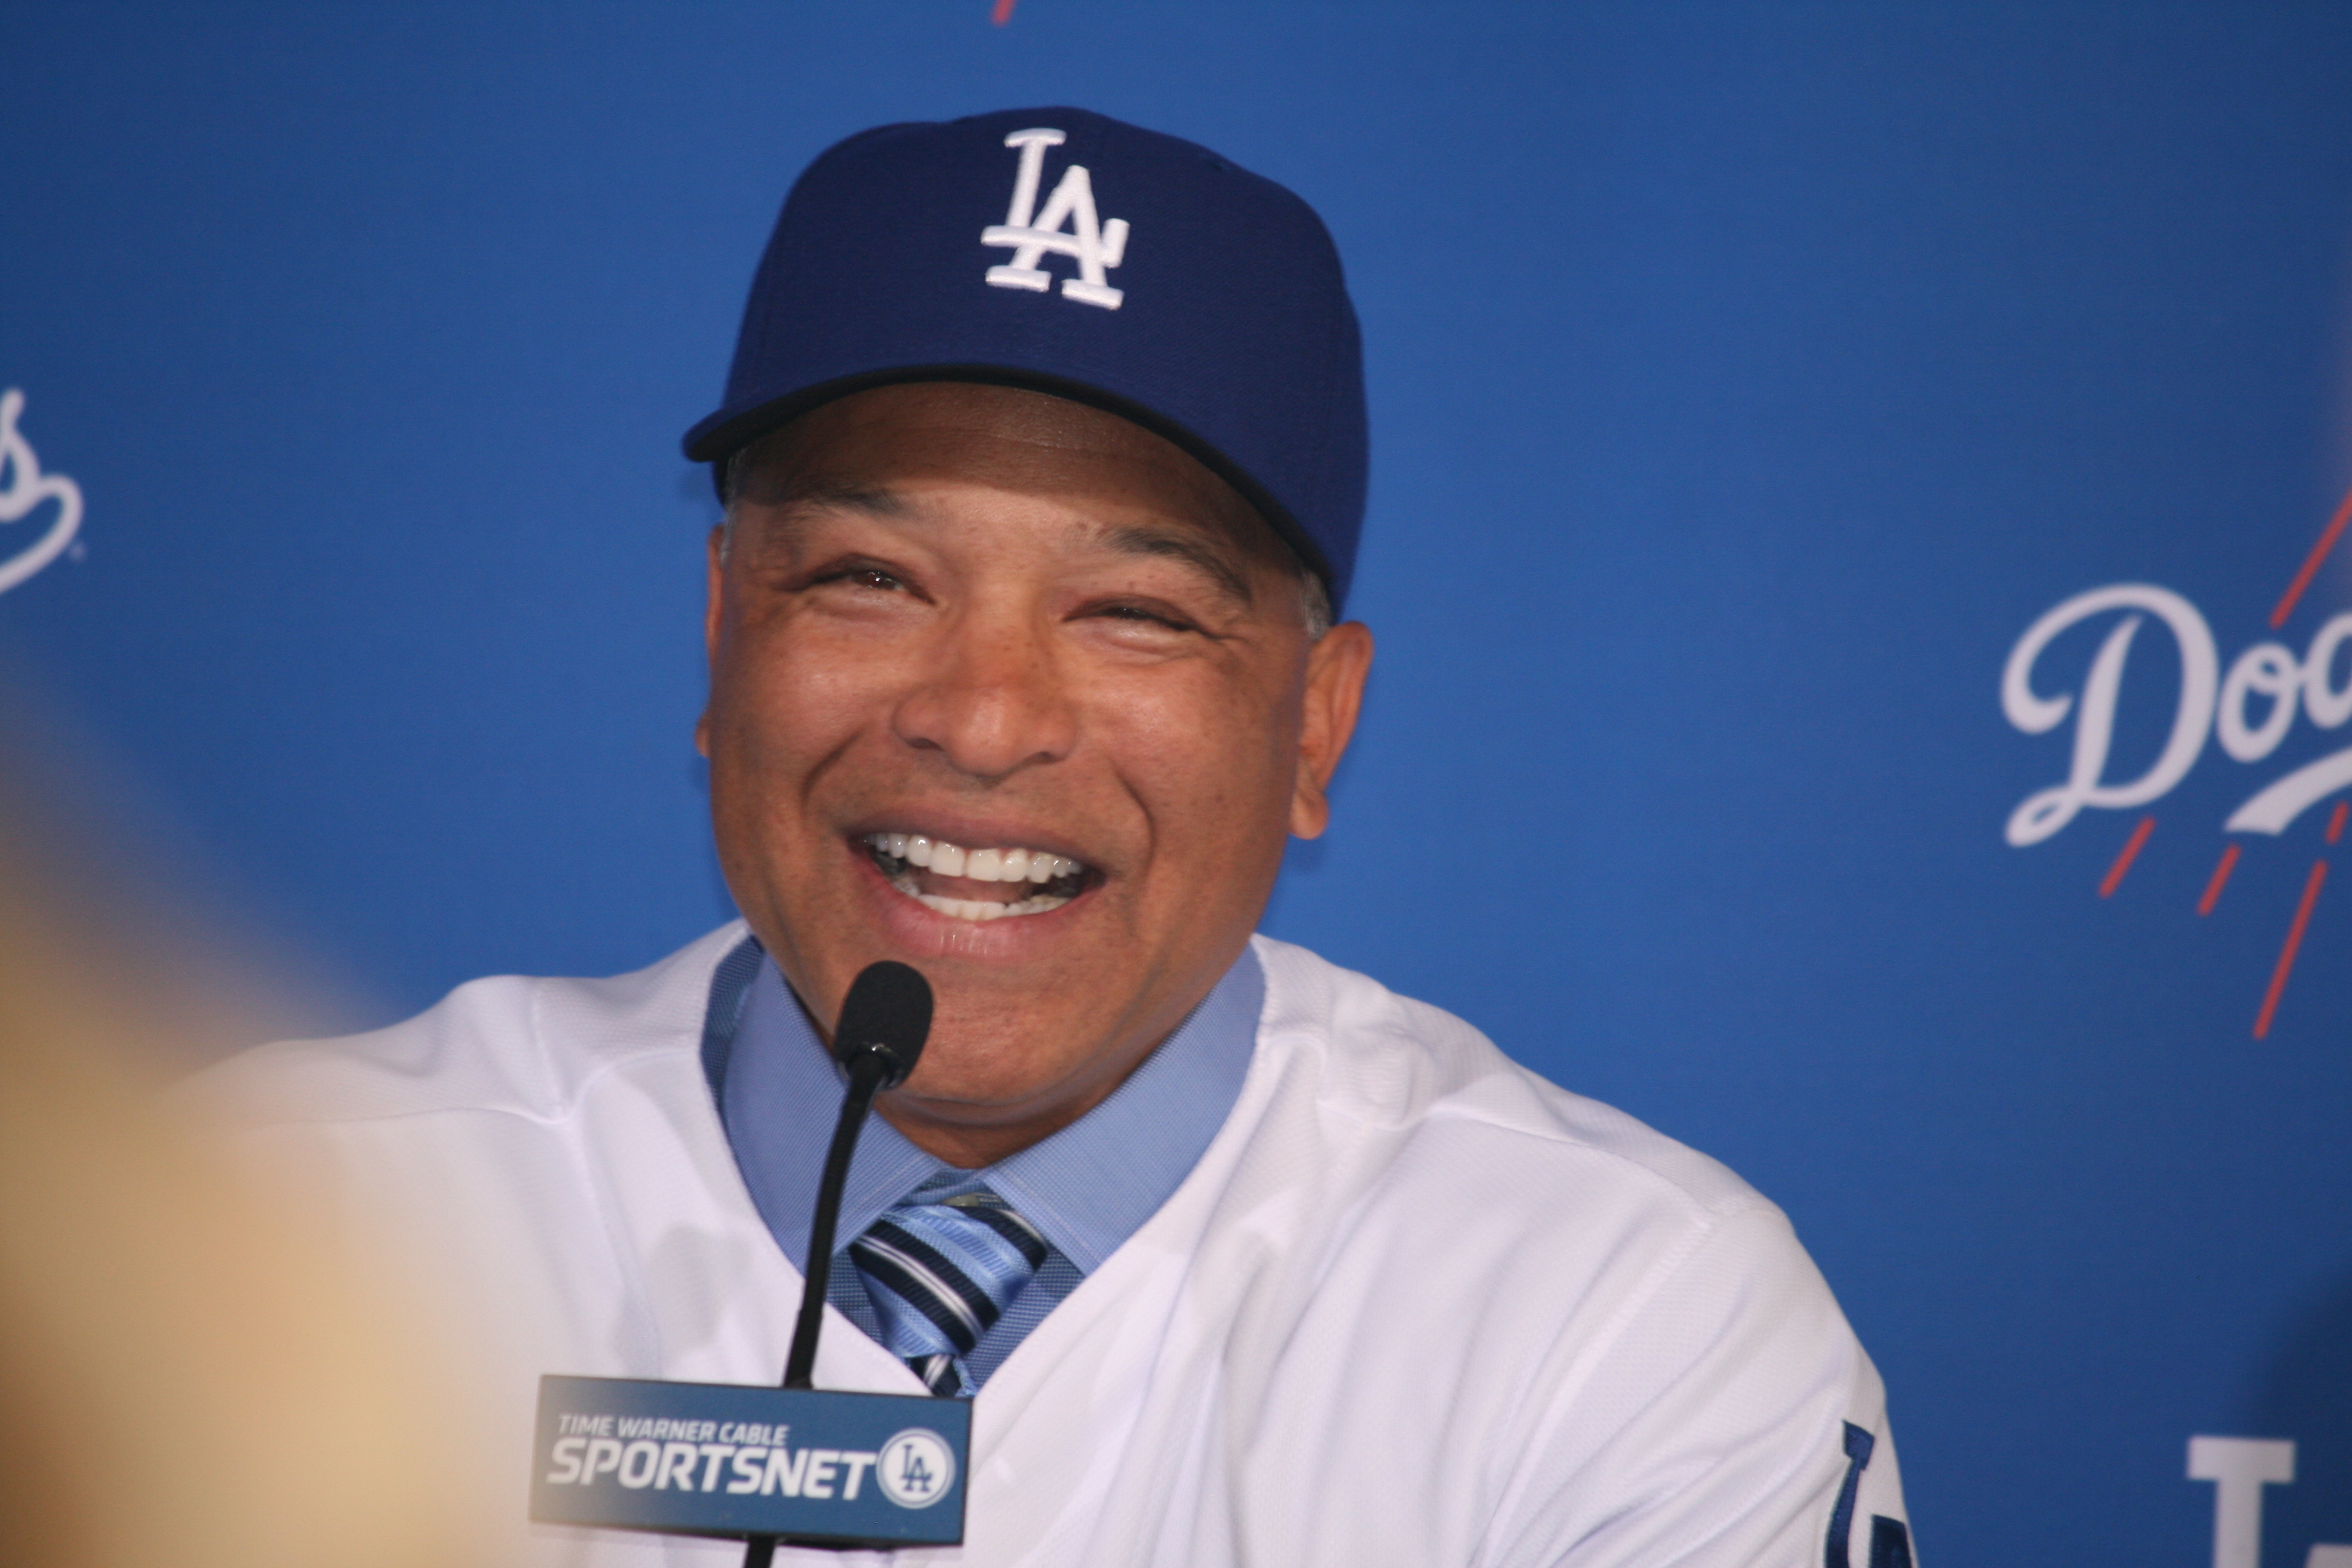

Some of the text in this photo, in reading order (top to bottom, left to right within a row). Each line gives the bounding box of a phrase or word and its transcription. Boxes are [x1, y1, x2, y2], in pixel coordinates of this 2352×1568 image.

[980, 127, 1131, 311] LA
[559, 1414, 790, 1446] TIME WARNER CABLE
[546, 1437, 877, 1501] SPORTSNET
[900, 1442, 933, 1493] LA
